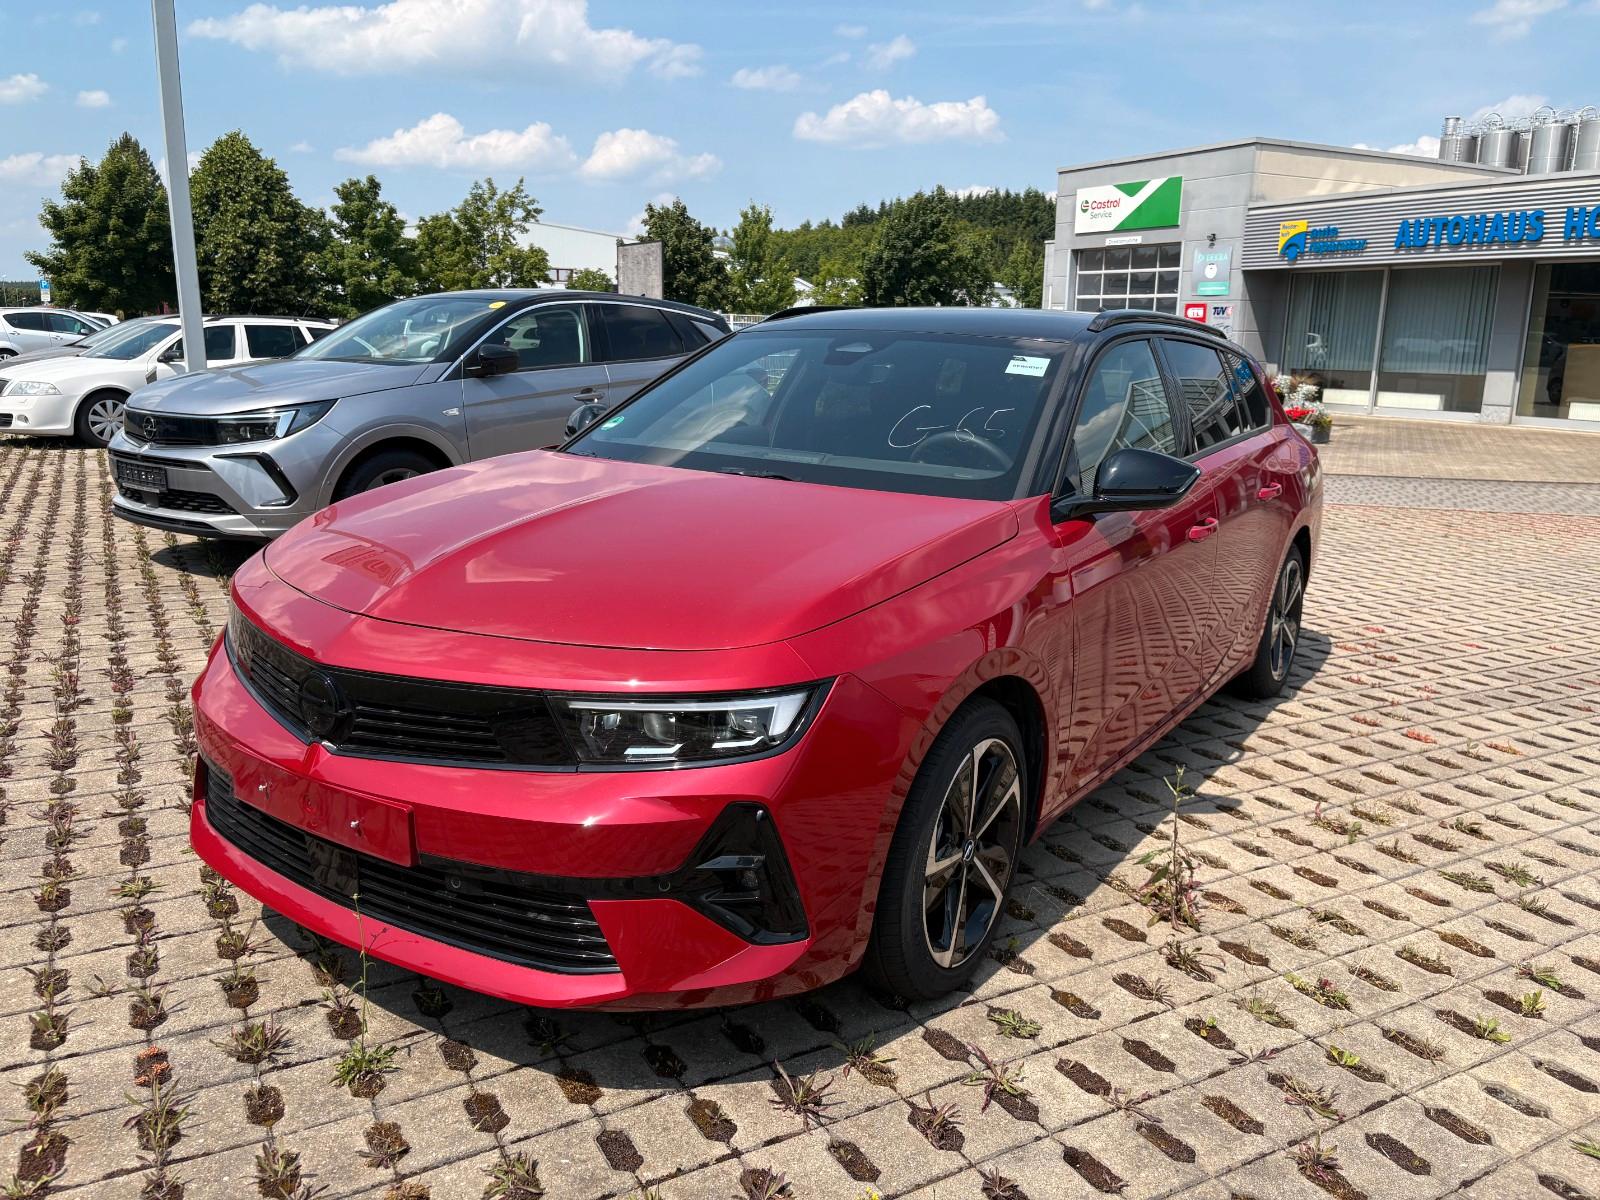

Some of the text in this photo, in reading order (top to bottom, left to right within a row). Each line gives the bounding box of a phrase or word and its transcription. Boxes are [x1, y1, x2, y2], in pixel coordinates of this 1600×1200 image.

[1091, 198, 1121, 210] Castrol
[1090, 210, 1112, 220] Service
[1394, 209, 1545, 249] AUTOHAUS
